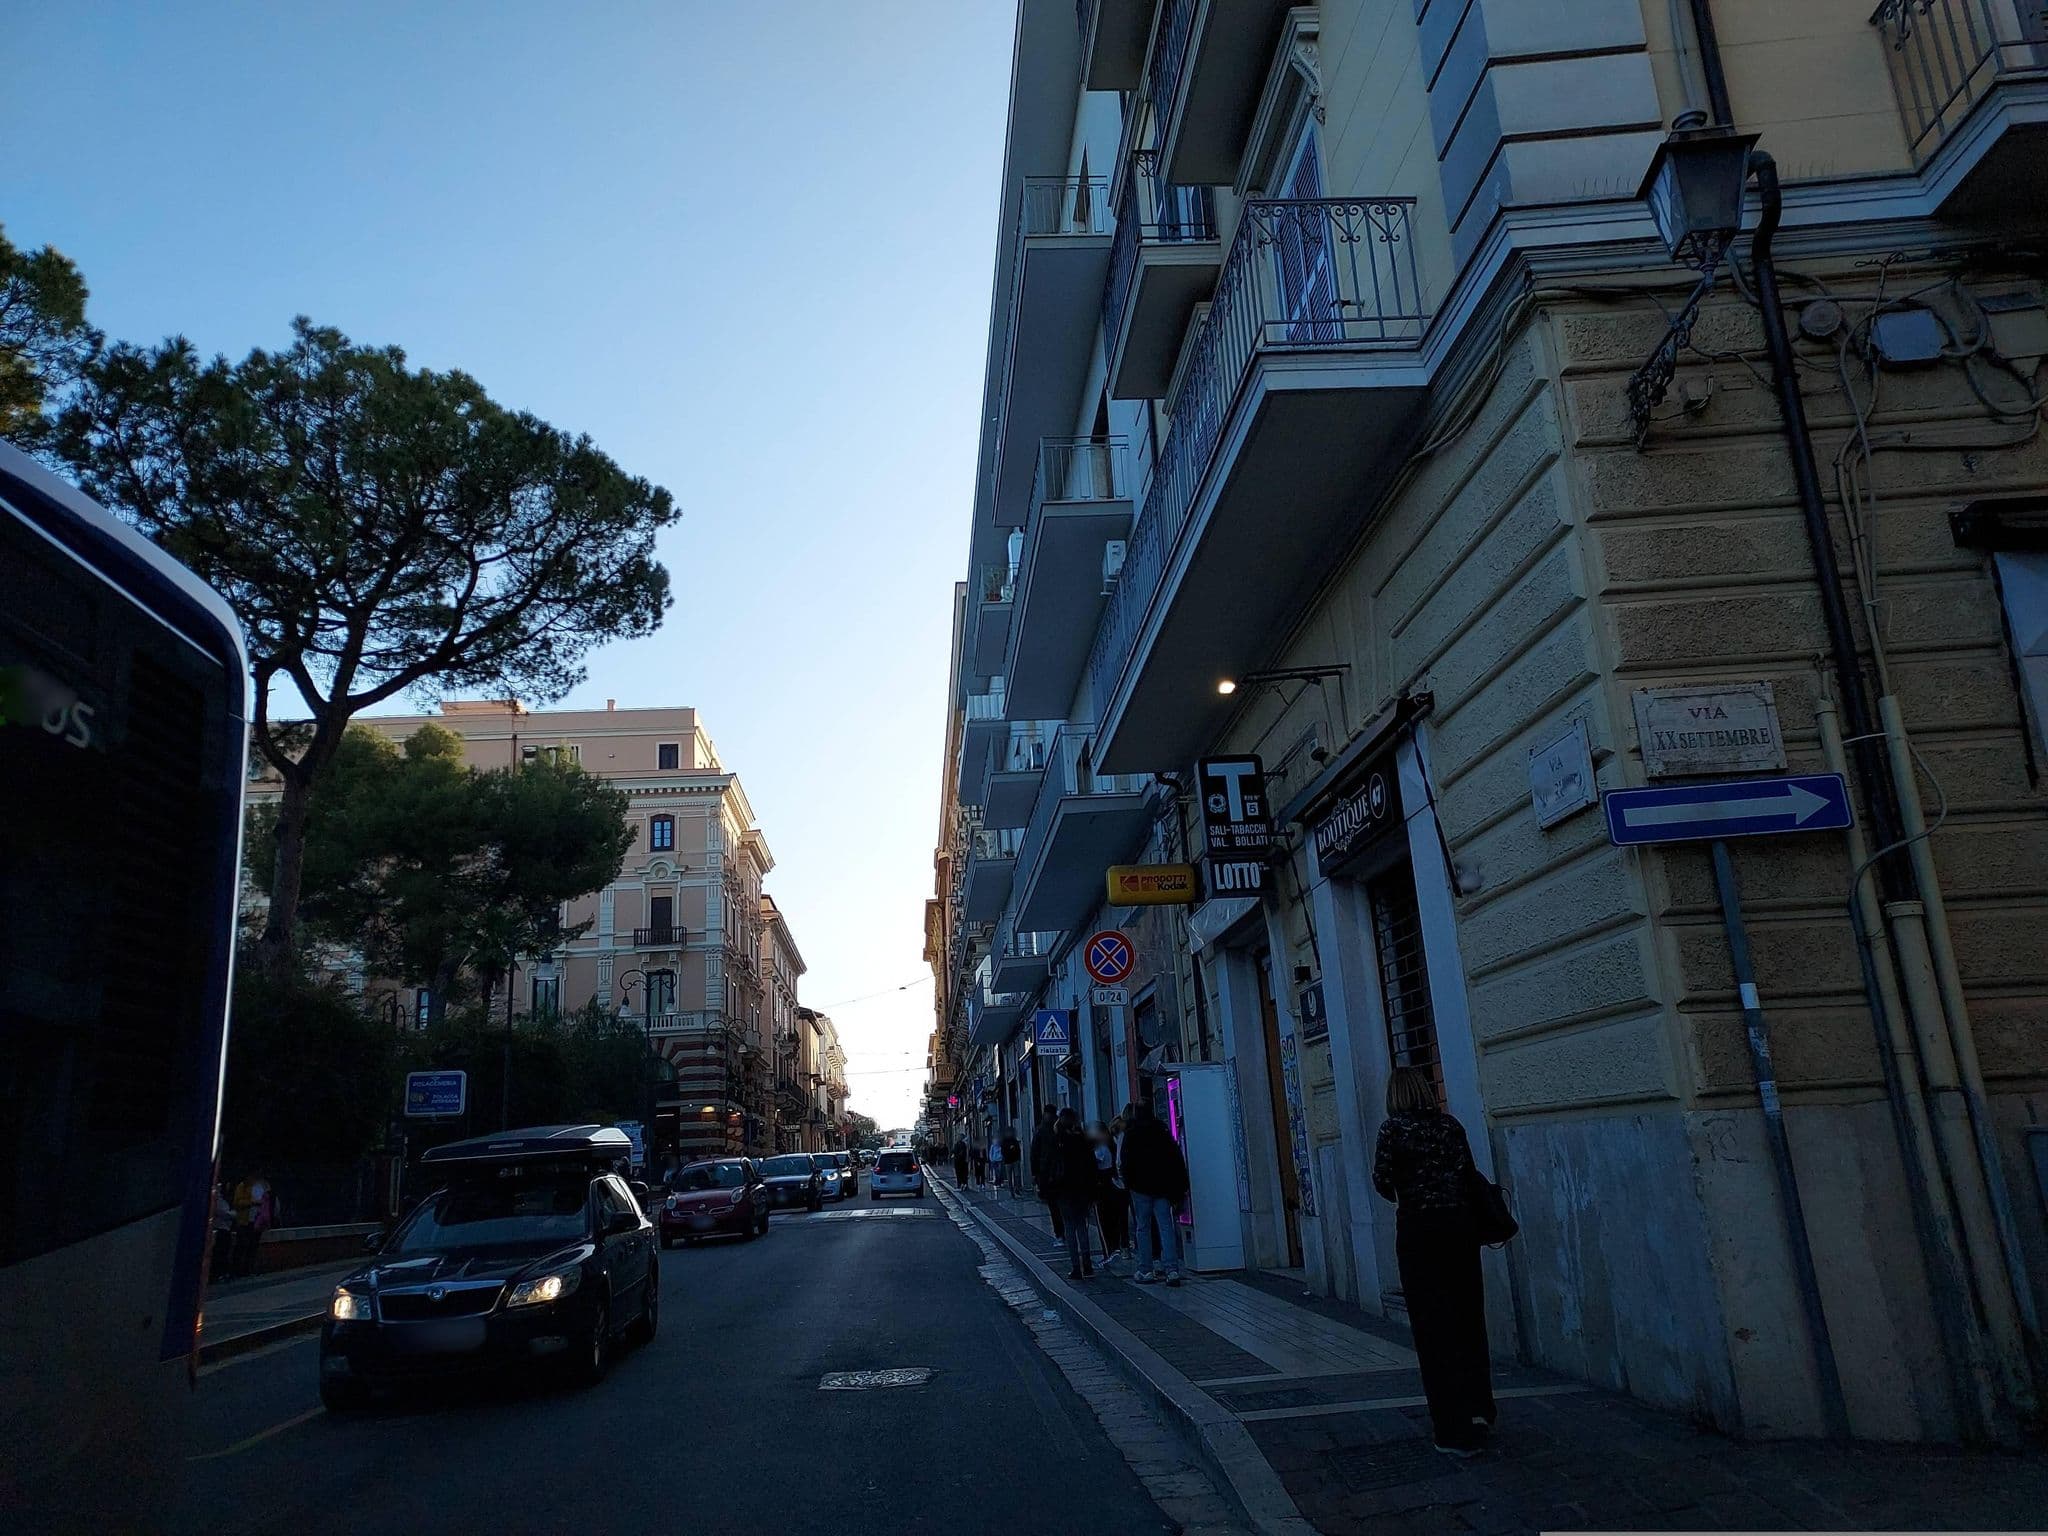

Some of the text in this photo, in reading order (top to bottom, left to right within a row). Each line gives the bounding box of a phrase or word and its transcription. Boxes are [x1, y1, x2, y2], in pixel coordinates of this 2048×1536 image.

[1687, 706, 1728, 720] VIA
[1654, 728, 1771, 751] XX SETTEMBRE
[1207, 761, 1257, 822] T
[1317, 793, 1369, 854] BOUTIQUE
[1234, 835, 1269, 847] BOLLATI
[1214, 861, 1262, 890] LOTTO
[1157, 881, 1188, 891] Kodak
[1110, 991, 1122, 1002] 24
[1040, 1045, 1067, 1054] rialzato
